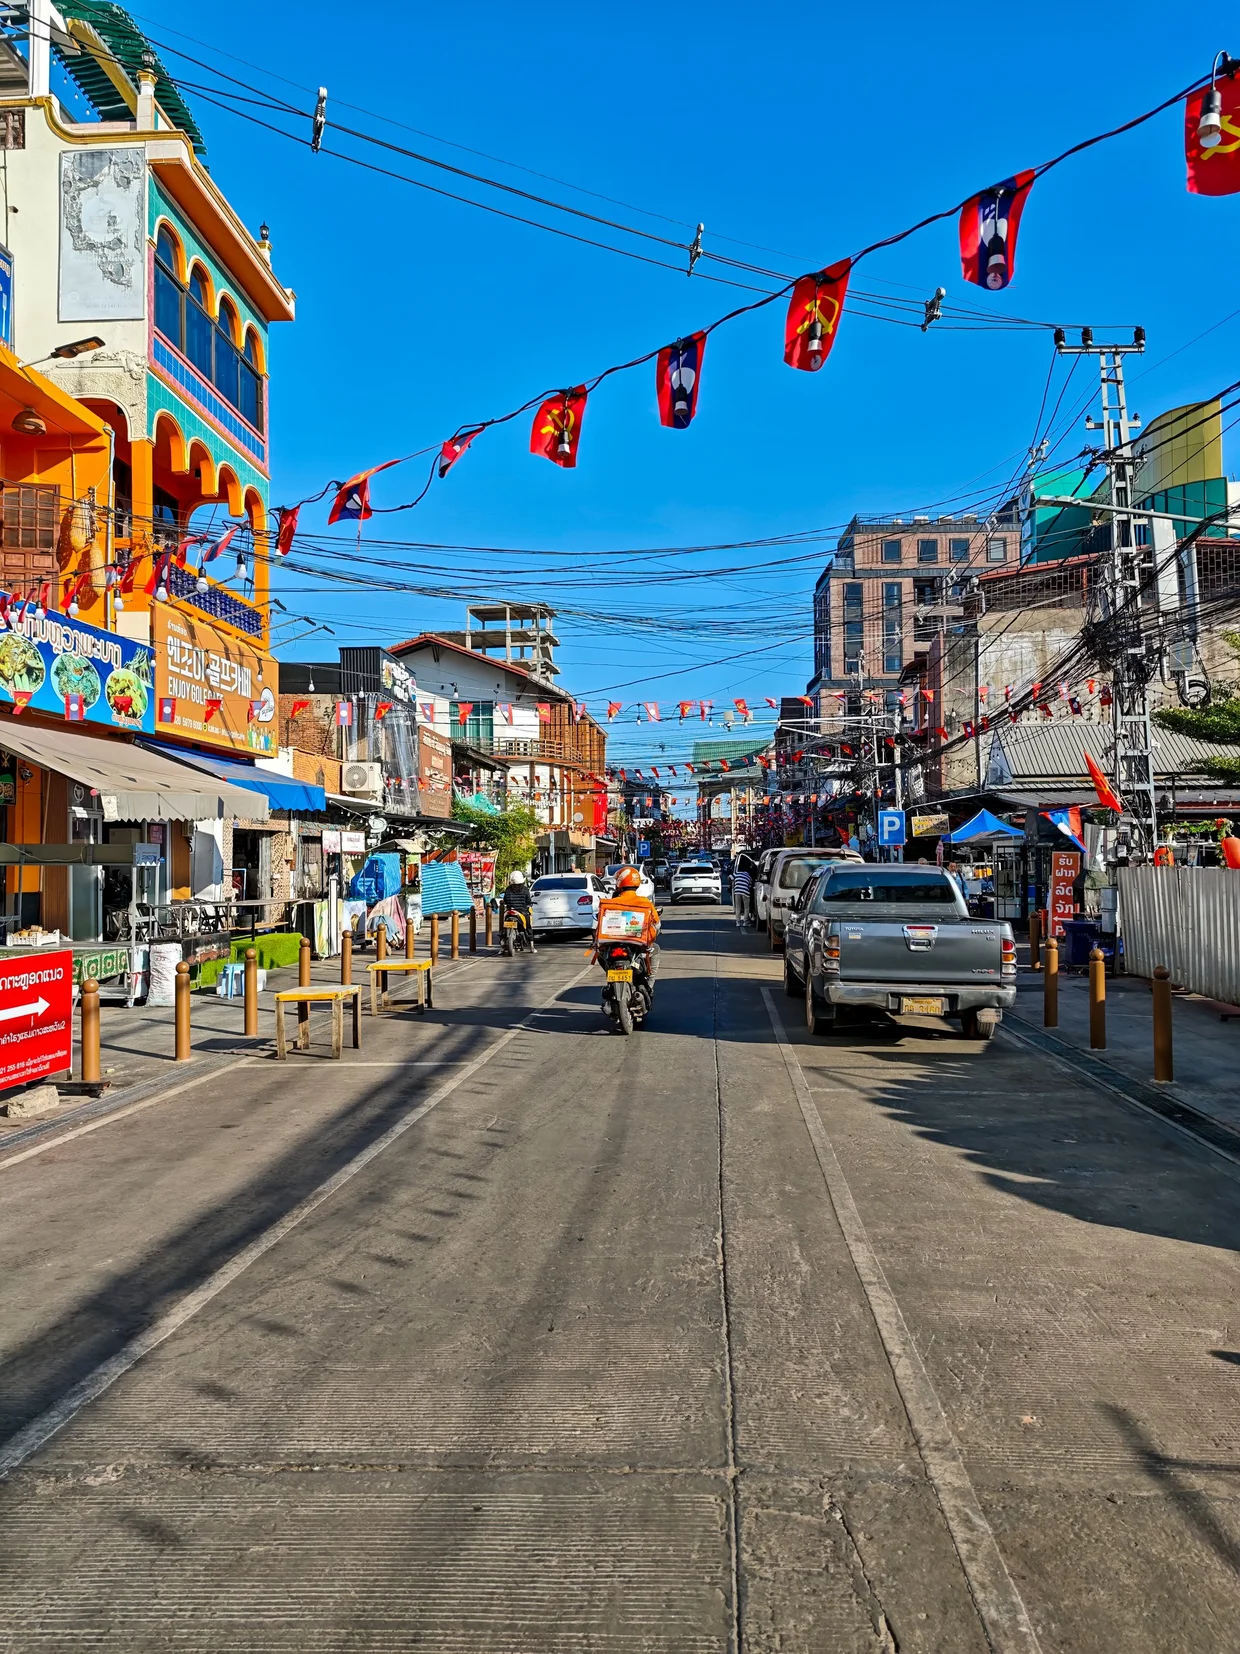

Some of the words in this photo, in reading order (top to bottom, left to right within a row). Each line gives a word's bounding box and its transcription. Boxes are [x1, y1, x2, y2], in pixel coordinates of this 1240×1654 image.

[167, 636, 205, 682] 엔조이
[209, 653, 251, 698] 골프카페
[168, 676, 190, 700] ENJOY
[191, 684, 207, 706] GOLF
[883, 816, 900, 840] P
[640, 843, 648, 854] P
